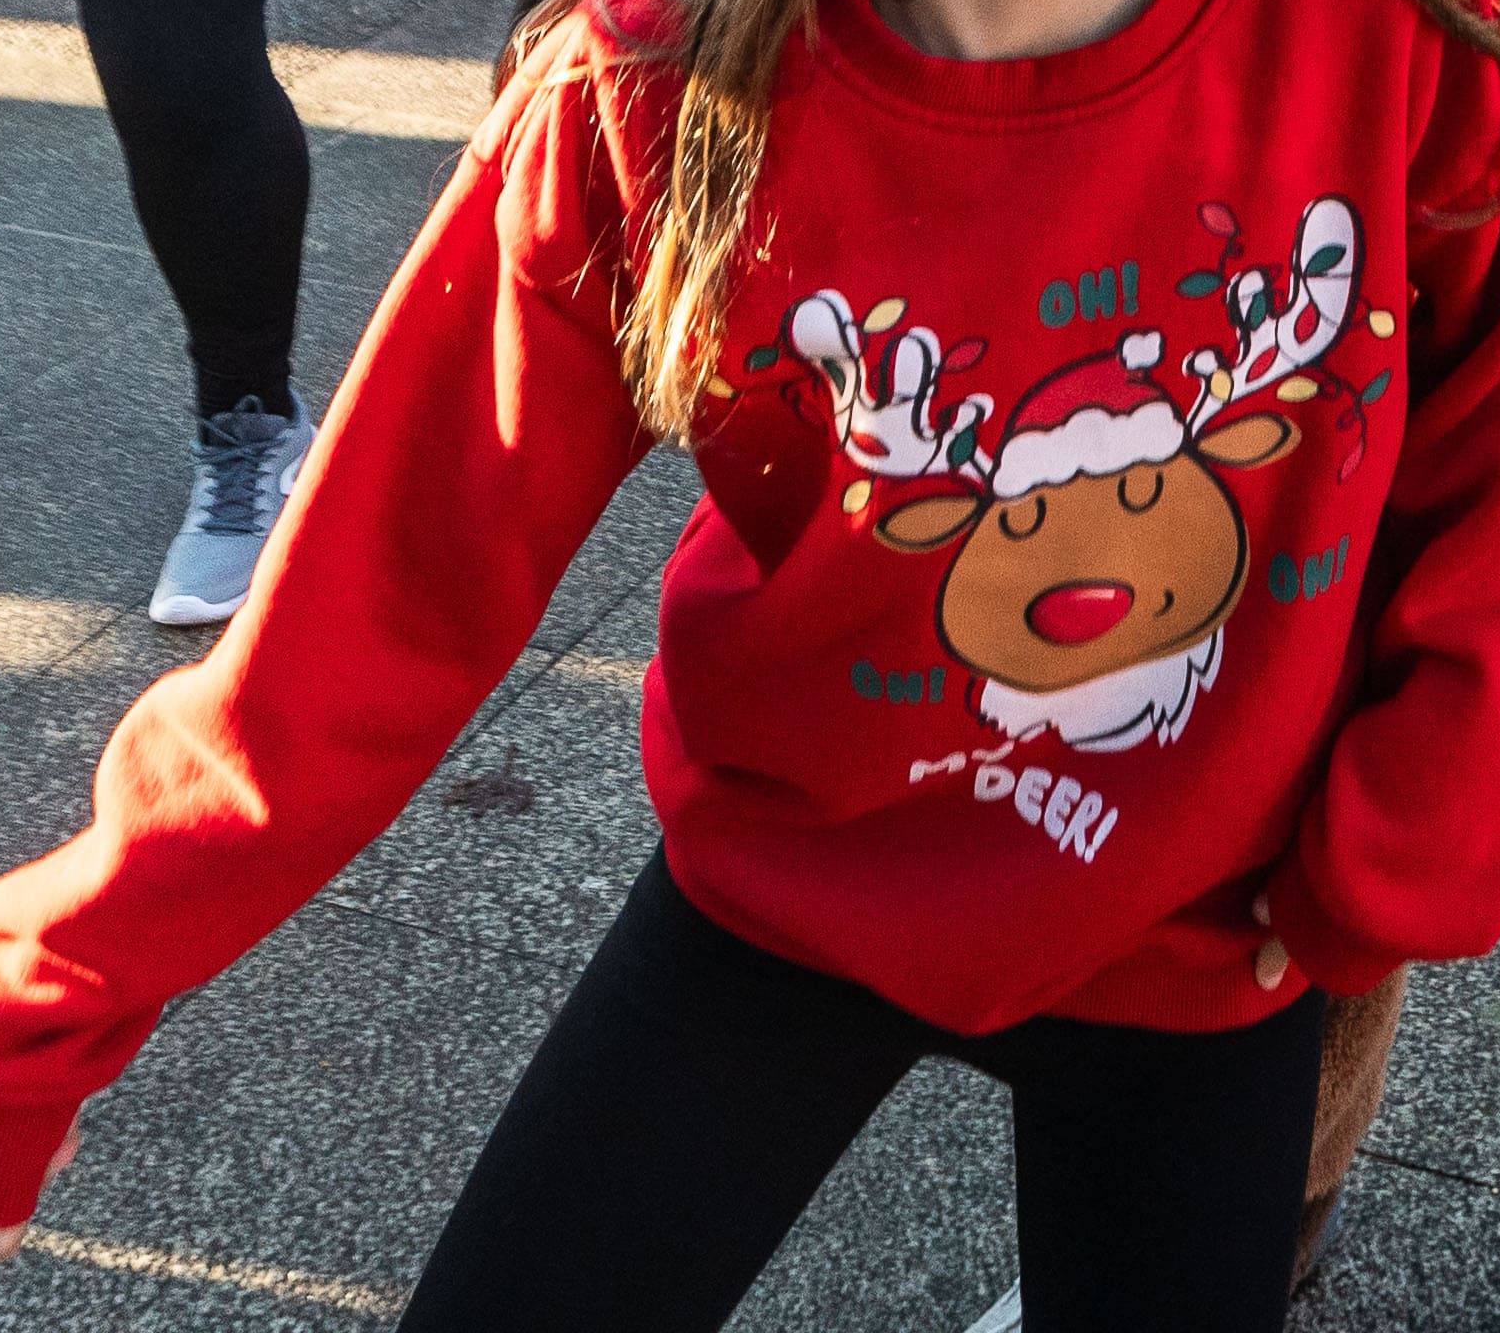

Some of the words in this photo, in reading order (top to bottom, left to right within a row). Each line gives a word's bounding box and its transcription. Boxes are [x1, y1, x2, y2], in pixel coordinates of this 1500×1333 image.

[1039, 259, 1140, 329] OH!
[1267, 535, 1350, 606] OH!
[850, 660, 947, 706] OH!
[973, 763, 1119, 864] DEER!
